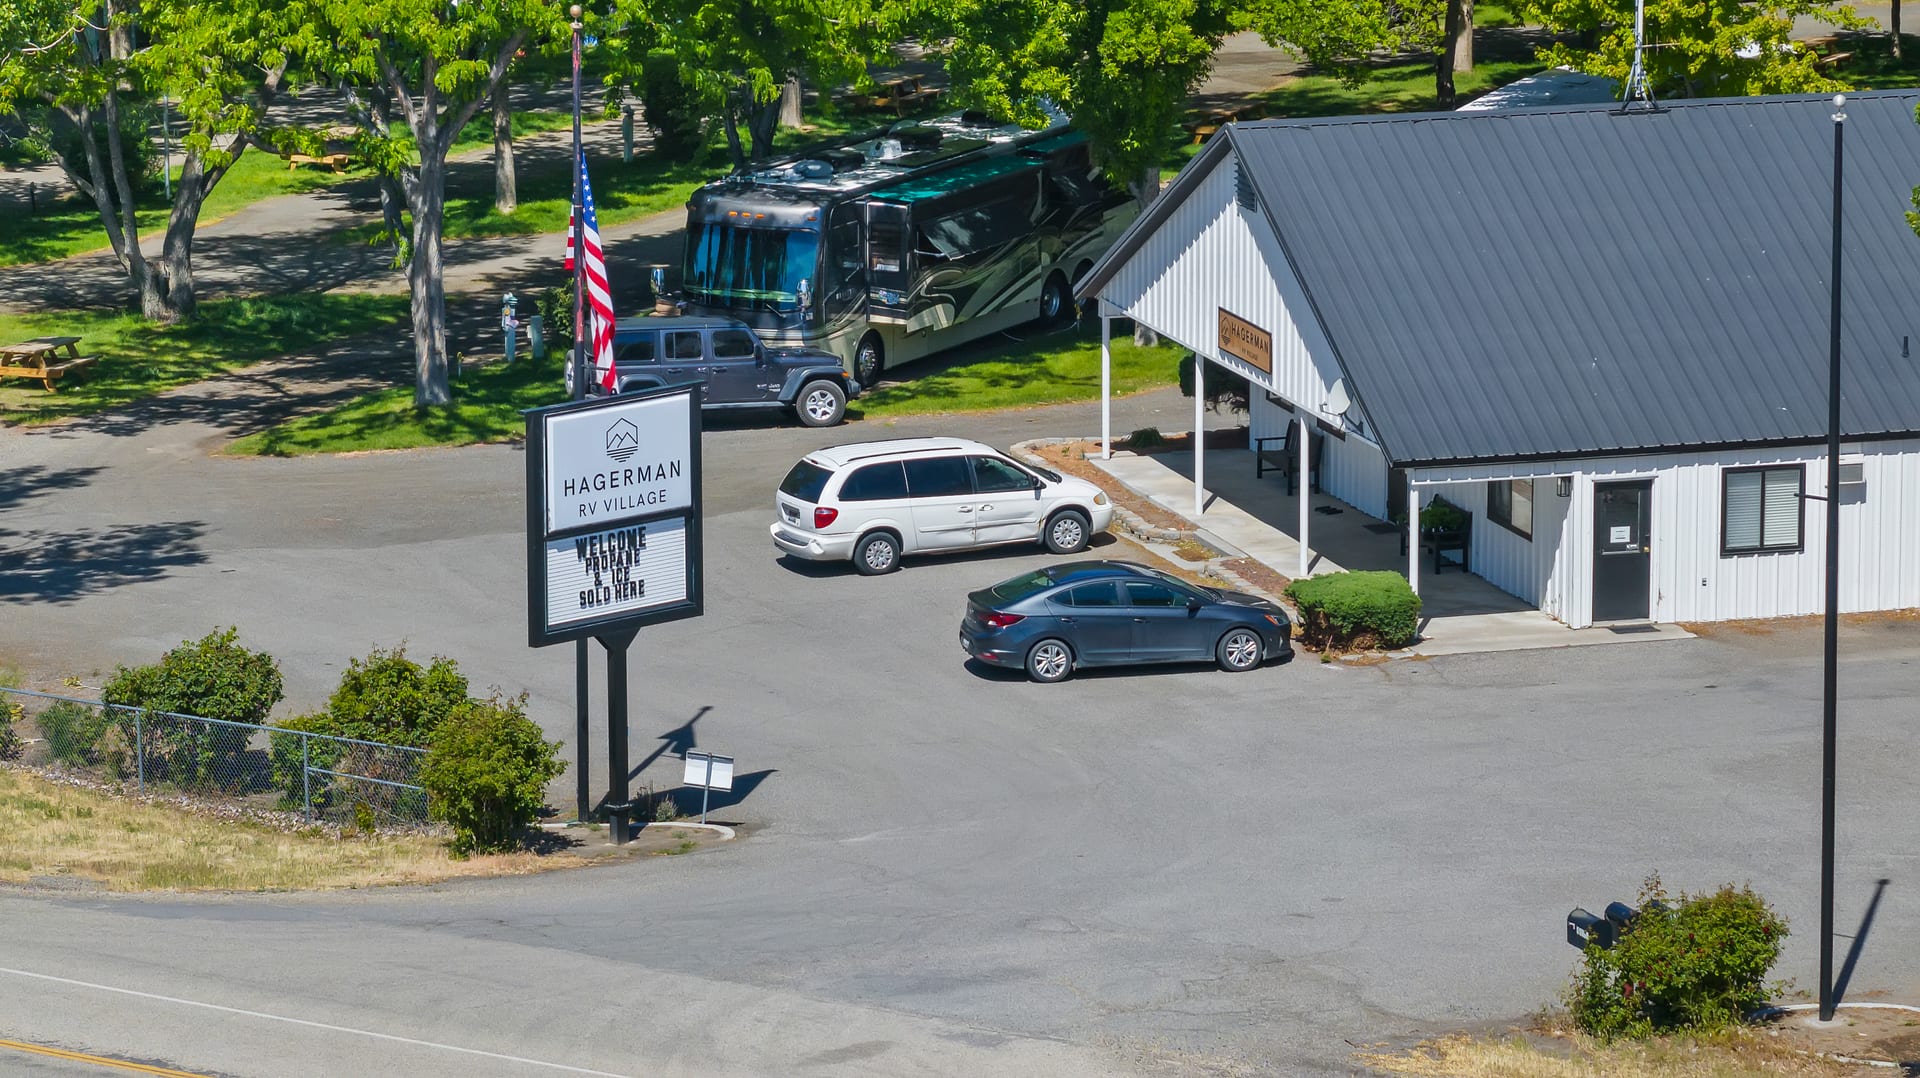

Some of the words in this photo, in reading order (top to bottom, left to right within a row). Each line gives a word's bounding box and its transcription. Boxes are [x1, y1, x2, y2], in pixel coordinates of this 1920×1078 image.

[1232, 322, 1269, 354] HAGERMAN
[564, 459, 681, 497] HAGERMAN
[579, 501, 597, 517] RV
[603, 489, 667, 513] VILLAGE
[575, 526, 647, 560] WELCOME
[585, 548, 640, 574] PROPANE
[594, 571, 603, 587] &
[611, 566, 630, 585] ICE
[579, 586, 611, 607] SOLD
[614, 579, 645, 601] HERE
